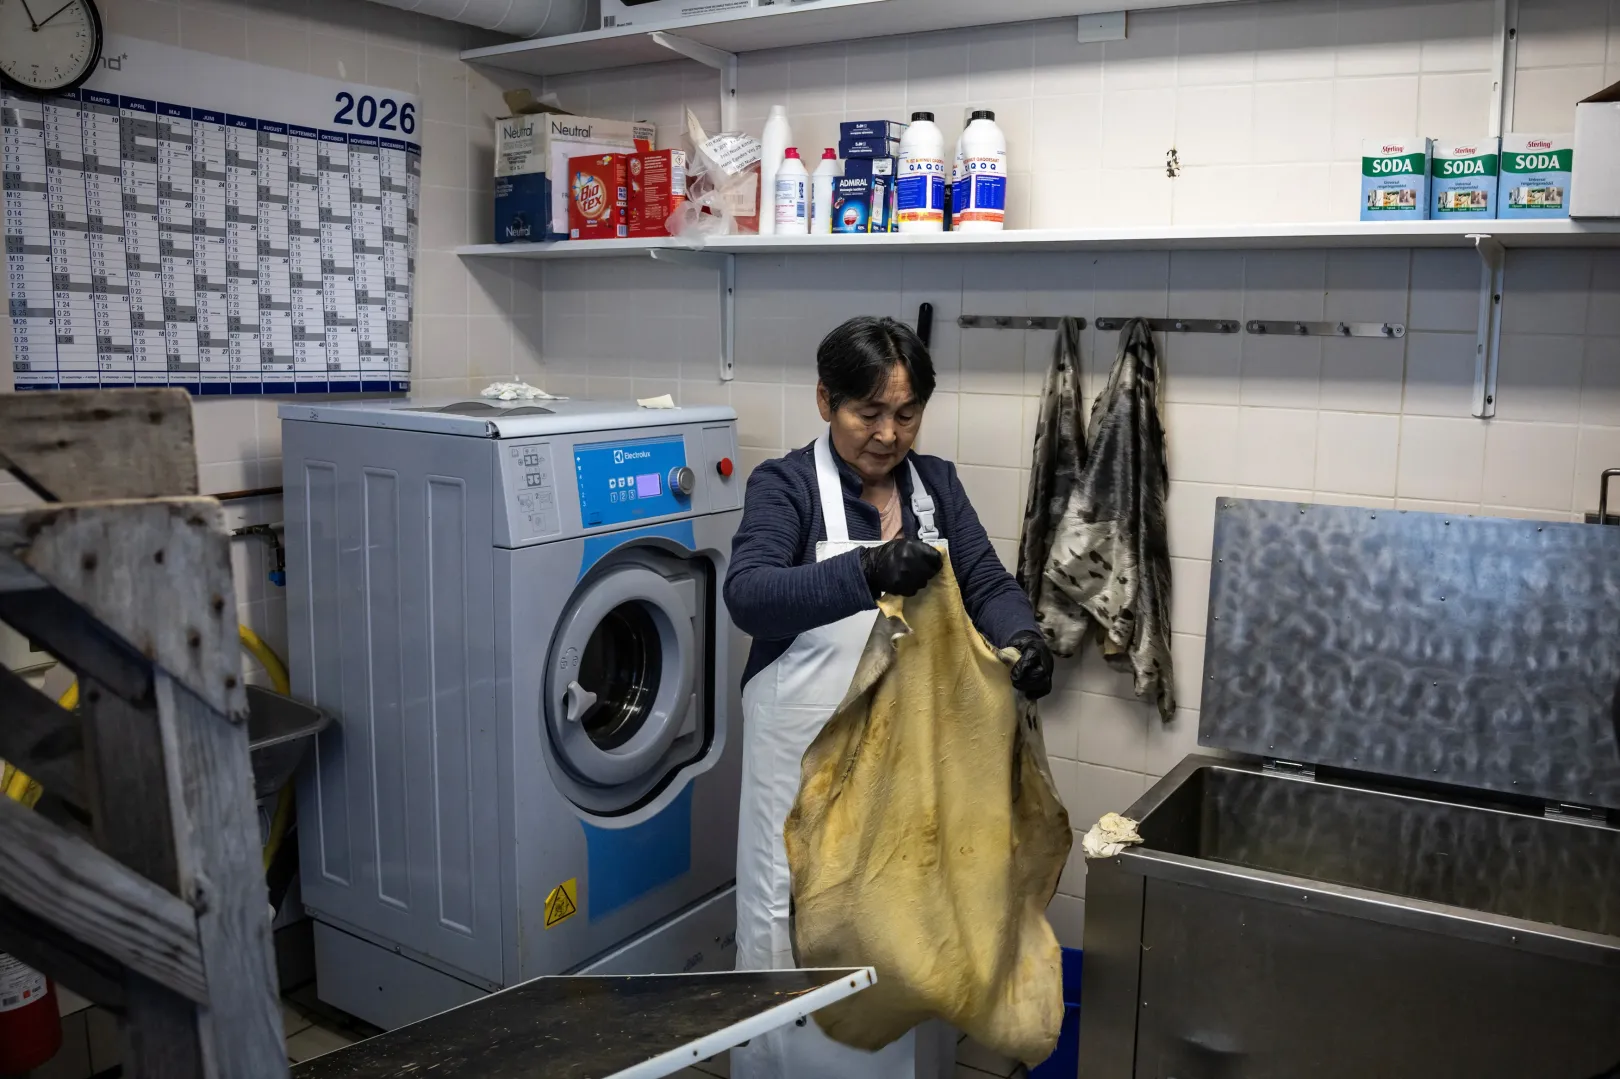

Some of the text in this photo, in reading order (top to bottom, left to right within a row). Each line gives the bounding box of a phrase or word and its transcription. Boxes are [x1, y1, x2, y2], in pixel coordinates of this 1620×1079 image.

[90, 96, 110, 104] MARTS
[334, 92, 415, 134] 2026
[551, 121, 591, 138] Neutral
[1373, 159, 1412, 172] SODA
[1444, 160, 1484, 174] SODA
[1515, 155, 1560, 169] SODA
[840, 178, 868, 187] ADMIRAL
[506, 226, 531, 237] Neutral
[624, 451, 650, 459] Electrolux
